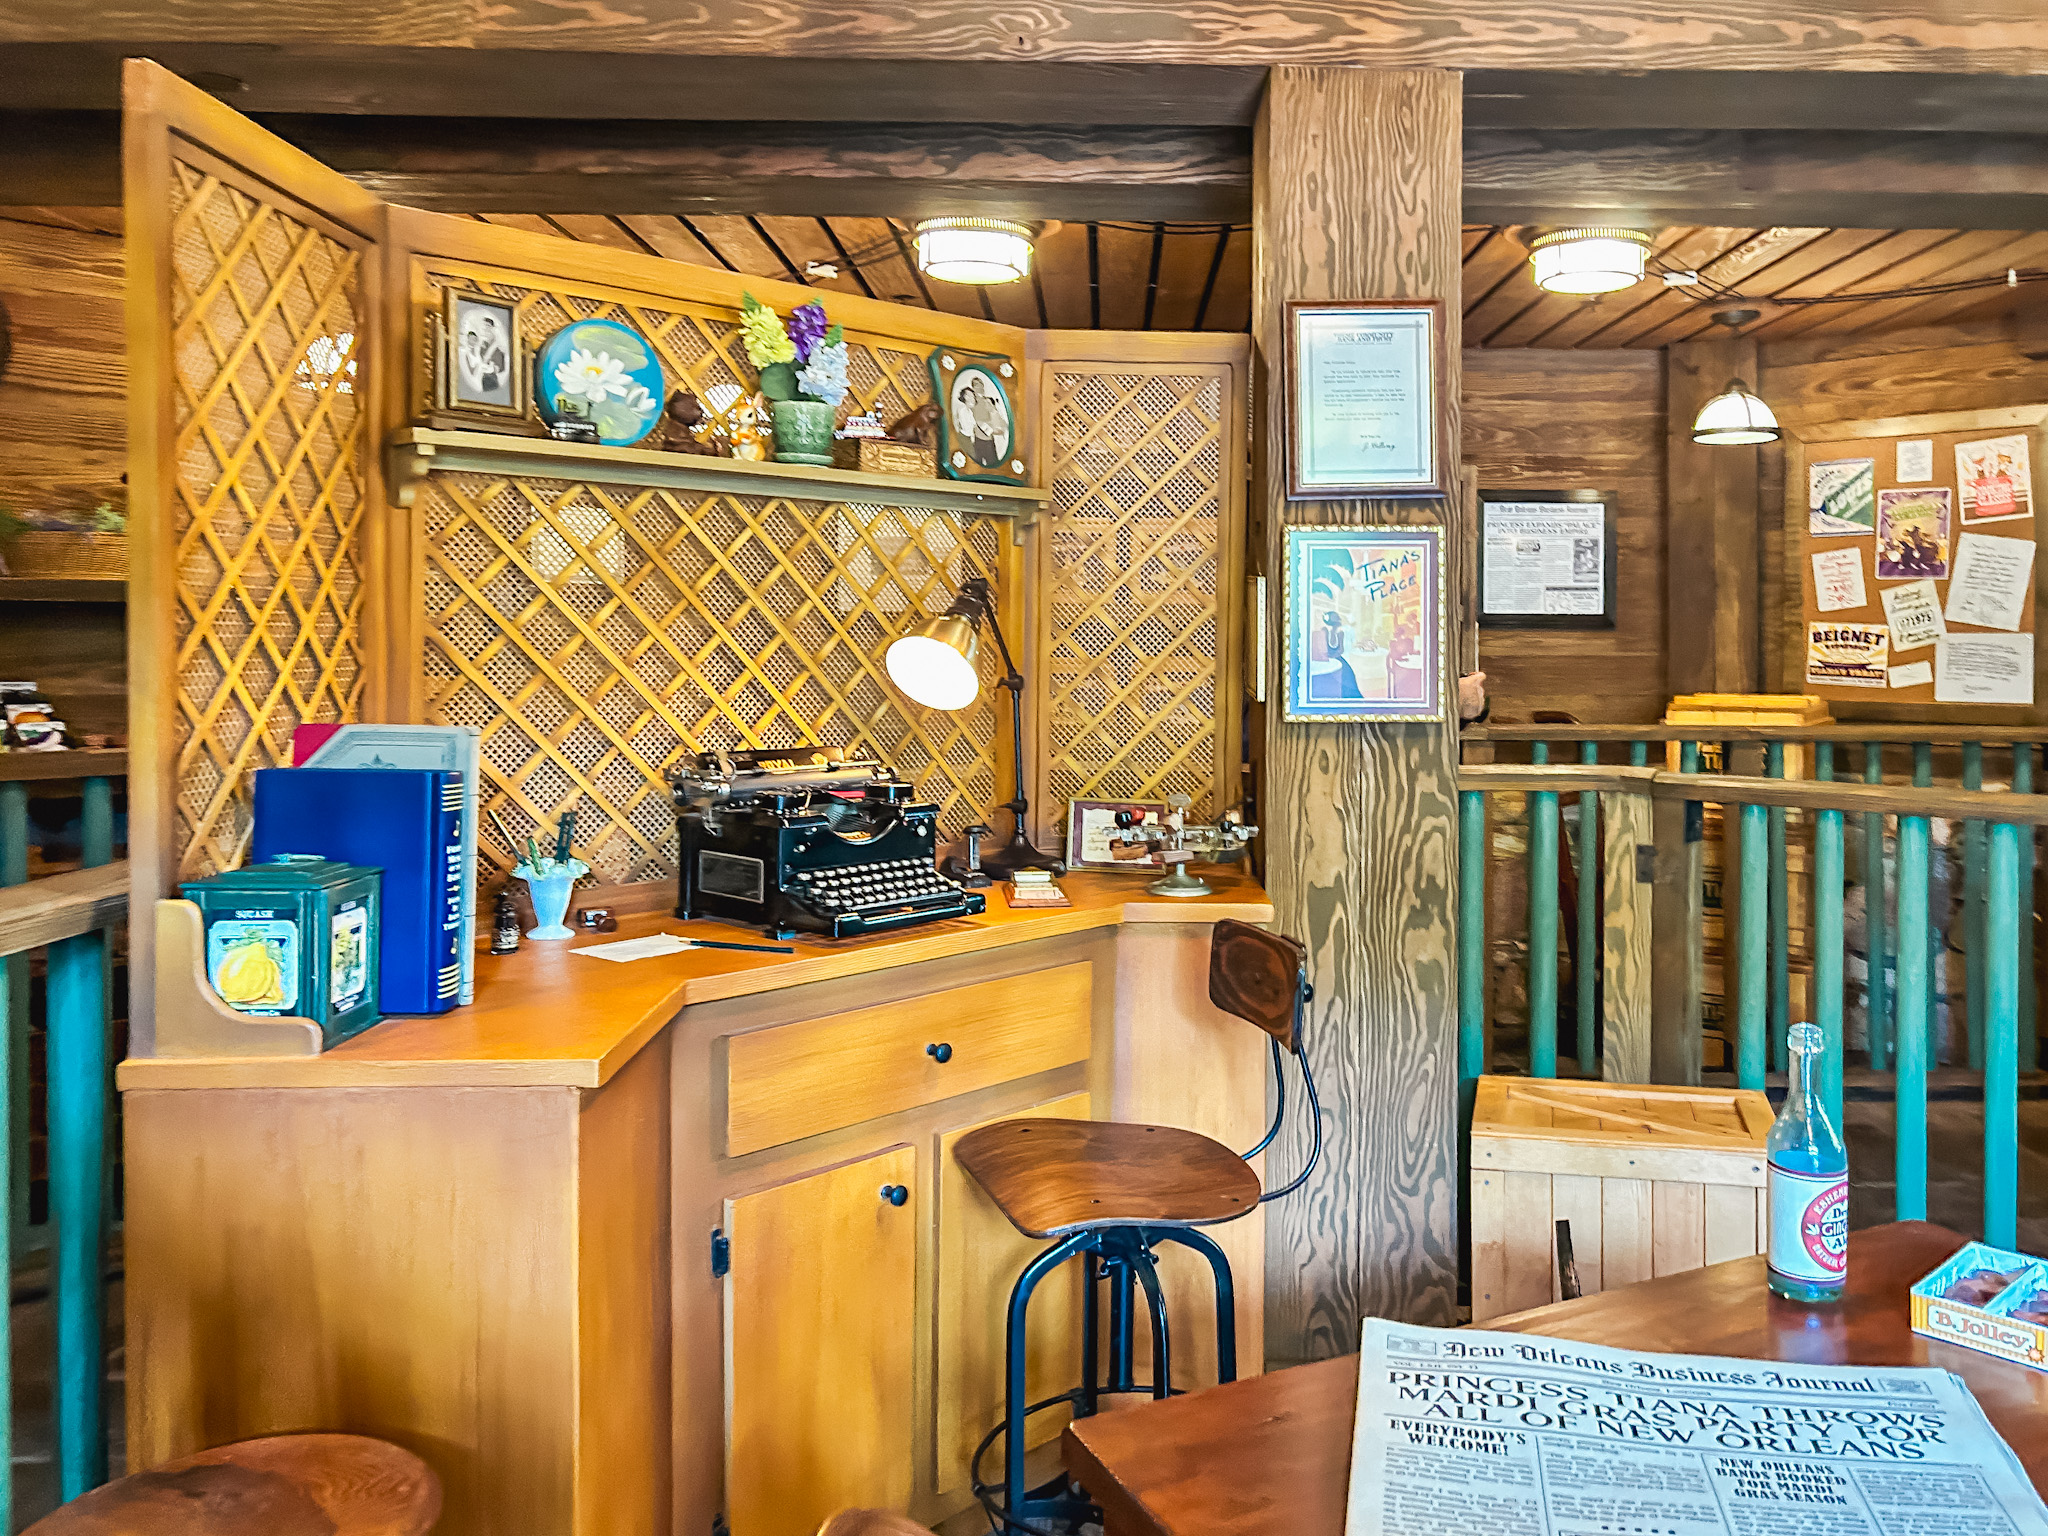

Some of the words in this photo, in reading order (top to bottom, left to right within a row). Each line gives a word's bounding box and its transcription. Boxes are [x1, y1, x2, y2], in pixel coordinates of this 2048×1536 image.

[1357, 551, 1421, 582] TIANA'S
[1364, 574, 1417, 602] PLACE
[1813, 630, 1885, 646] BEIGNET
[1956, 1318, 2029, 1348] Jolley
[1443, 1341, 1504, 1359] New
[1511, 1344, 1623, 1374] Orleans
[1628, 1361, 1757, 1386] Business
[1762, 1371, 1878, 1392] Journal
[1389, 1371, 1589, 1400] PRINCESS
[1605, 1391, 1739, 1419] TIANA
[1753, 1405, 1946, 1429] THROWS
[1399, 1386, 1538, 1411] MARDI
[1557, 1400, 1676, 1427] GRAS
[1695, 1416, 1833, 1438] PARTY
[1855, 1425, 1947, 1445] FOR
[1390, 1419, 1526, 1446] EVERYBODY'S
[1408, 1432, 1509, 1457] WELCOME!
[1424, 1403, 1503, 1423] ALL
[1520, 1411, 1577, 1429] OF
[1597, 1418, 1695, 1444] NEW
[1716, 1432, 1925, 1459] ORLEANS
[1715, 1467, 1770, 1480] BANDS
[1777, 1472, 1847, 1486] BOOKED
[1719, 1457, 1754, 1469] NEW
[1761, 1461, 1835, 1475] ORLEANS
[1734, 1488, 1780, 1500] GRAS
[1784, 1492, 1848, 1505] SEASON
[1738, 1479, 1772, 1490] FOR
[1779, 1481, 1833, 1495] MARDI
